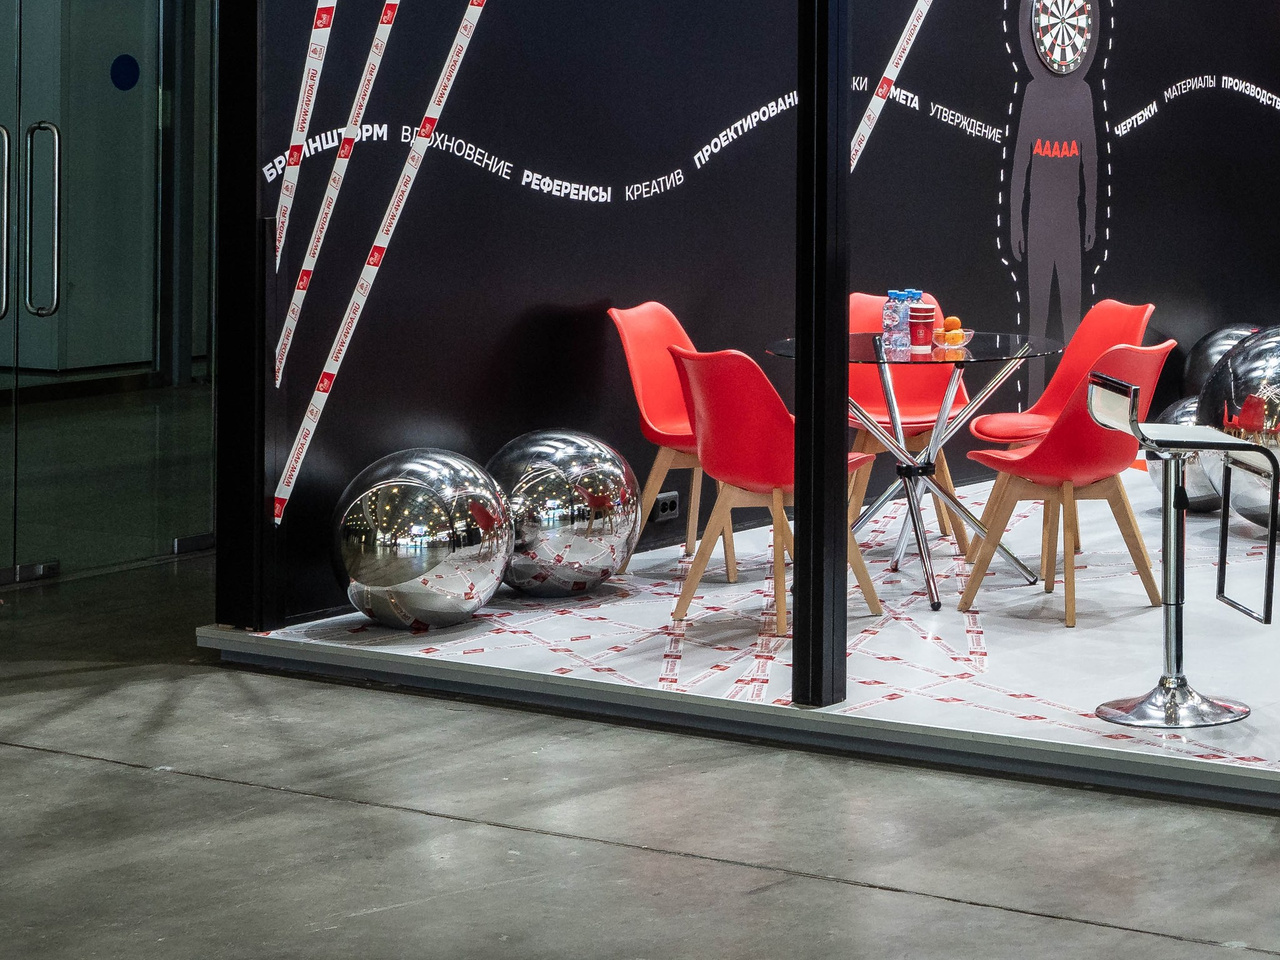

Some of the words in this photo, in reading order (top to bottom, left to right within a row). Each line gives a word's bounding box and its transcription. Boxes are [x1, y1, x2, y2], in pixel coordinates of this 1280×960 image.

[893, 10, 924, 69] WWW.4VIDA.RU
[298, 68, 318, 133] WWW.4VIDA.RU
[352, 63, 376, 126] WWW.4VIDA.RU
[436, 44, 464, 106] WWW.4VIDA.RU
[521, 169, 612, 202] РЕФЕРЕНСЫ
[625, 168, 684, 201] КРЕАТИВ
[693, 90, 799, 169] ПРОЕКТИРОВАН
[889, 84, 919, 111] МЕТА
[929, 102, 1002, 144] УТВЕРЖДЕНИЕ
[1115, 101, 1158, 137] ЧЕРТЕЖИ
[1164, 75, 1216, 103] МАТЕРИАЛЫ
[311, 197, 333, 258] WWW.4VIDA.RU
[383, 175, 412, 236] WWW.4VIDA.RU
[333, 302, 360, 363] WWW.4VIDA.RU
[285, 428, 311, 488] WWW.4VIDA.RU
